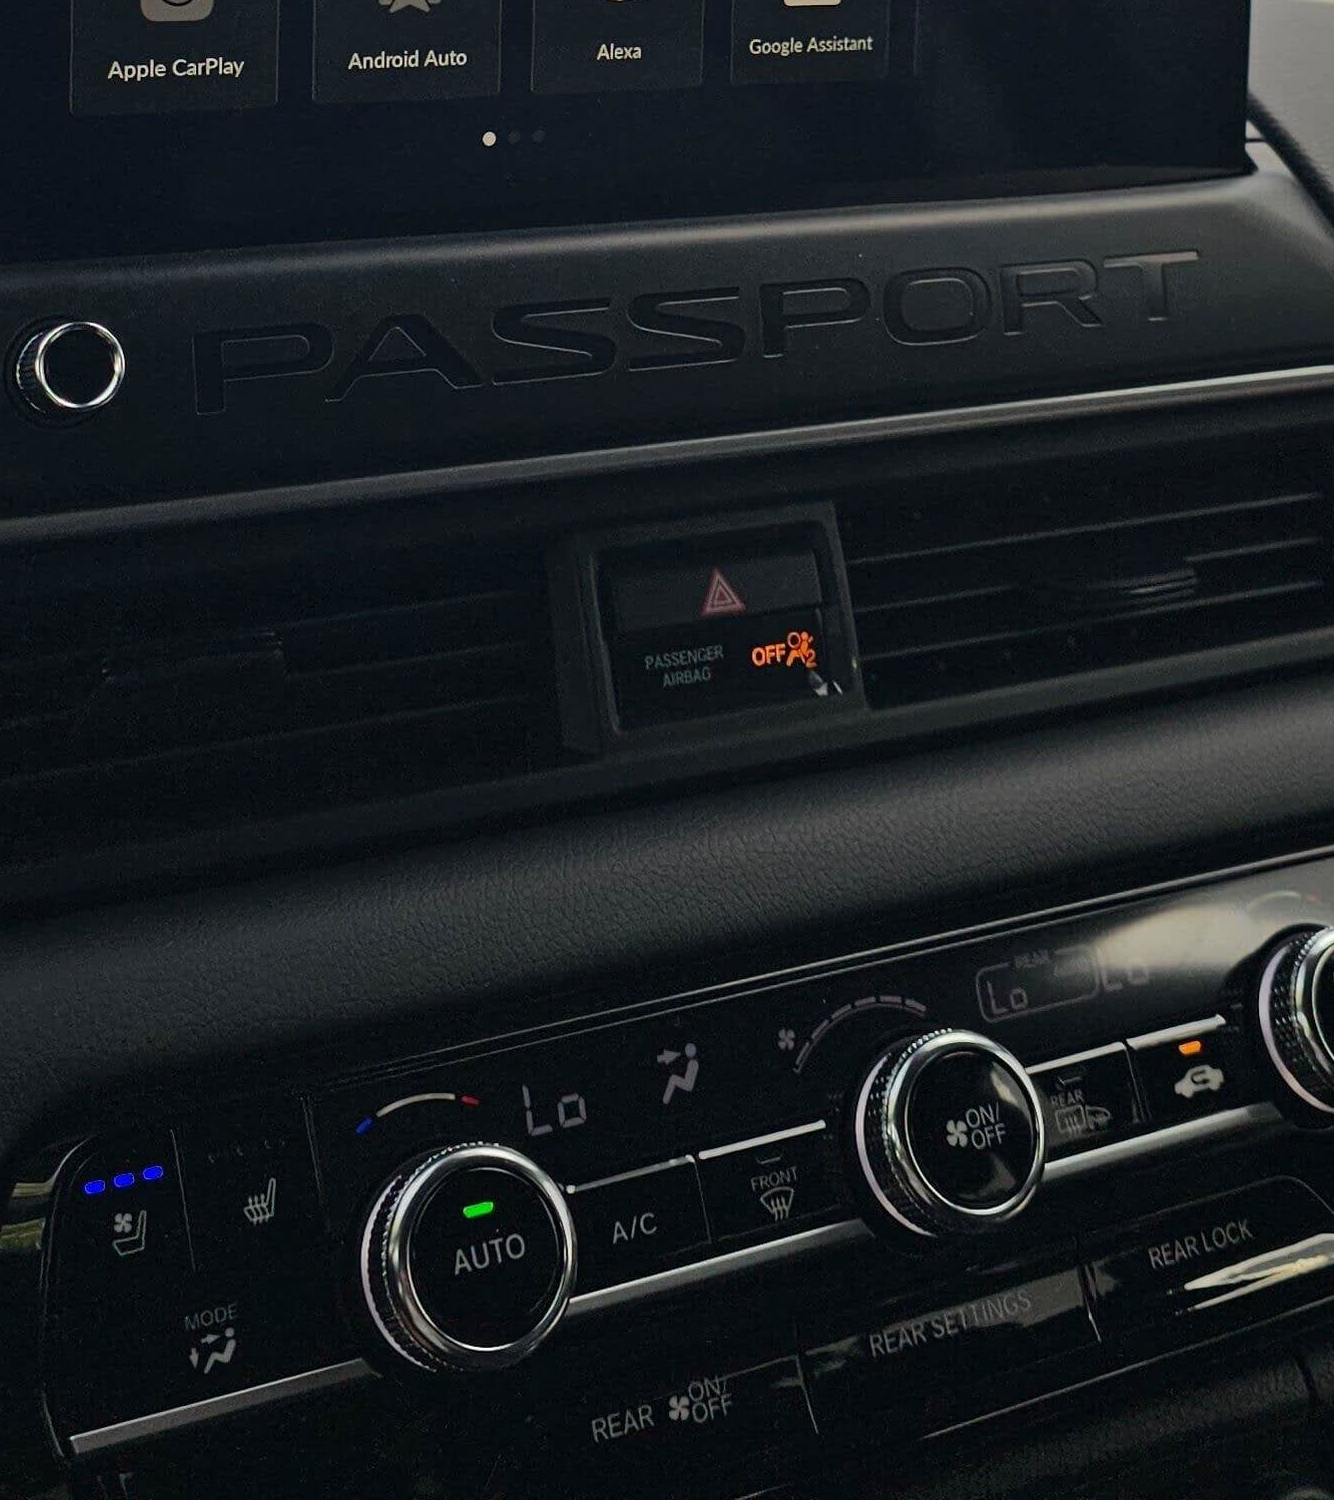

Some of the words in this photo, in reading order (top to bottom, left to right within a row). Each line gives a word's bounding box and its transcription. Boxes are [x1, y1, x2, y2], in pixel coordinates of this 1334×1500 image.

[597, 43, 641, 60] Alexa
[749, 37, 803, 56] Google
[807, 36, 873, 52] Assistant
[108, 59, 166, 81] Apple
[172, 57, 244, 77] CarPlay
[348, 50, 419, 69] Android
[424, 50, 467, 66] Auto
[192, 251, 1200, 416] PASSPORT
[644, 645, 724, 670] PASSENGER
[752, 641, 787, 666] OFF
[662, 667, 712, 687] AIRBAG
[967, 1104, 1002, 1131] ON/
[971, 1123, 1006, 1150] OFF
[750, 1168, 798, 1192] FRONT
[613, 1213, 657, 1244] A/C
[455, 1234, 525, 1275] AUTO
[1148, 1237, 1200, 1270] REAR
[1201, 1222, 1254, 1258] LOCK
[185, 1305, 238, 1330] MODE
[869, 1321, 928, 1356] REAR
[929, 1293, 1032, 1341] SETTINGS
[687, 1378, 728, 1401] ON/
[691, 1396, 733, 1425] OFF
[592, 1405, 654, 1442] REAR
